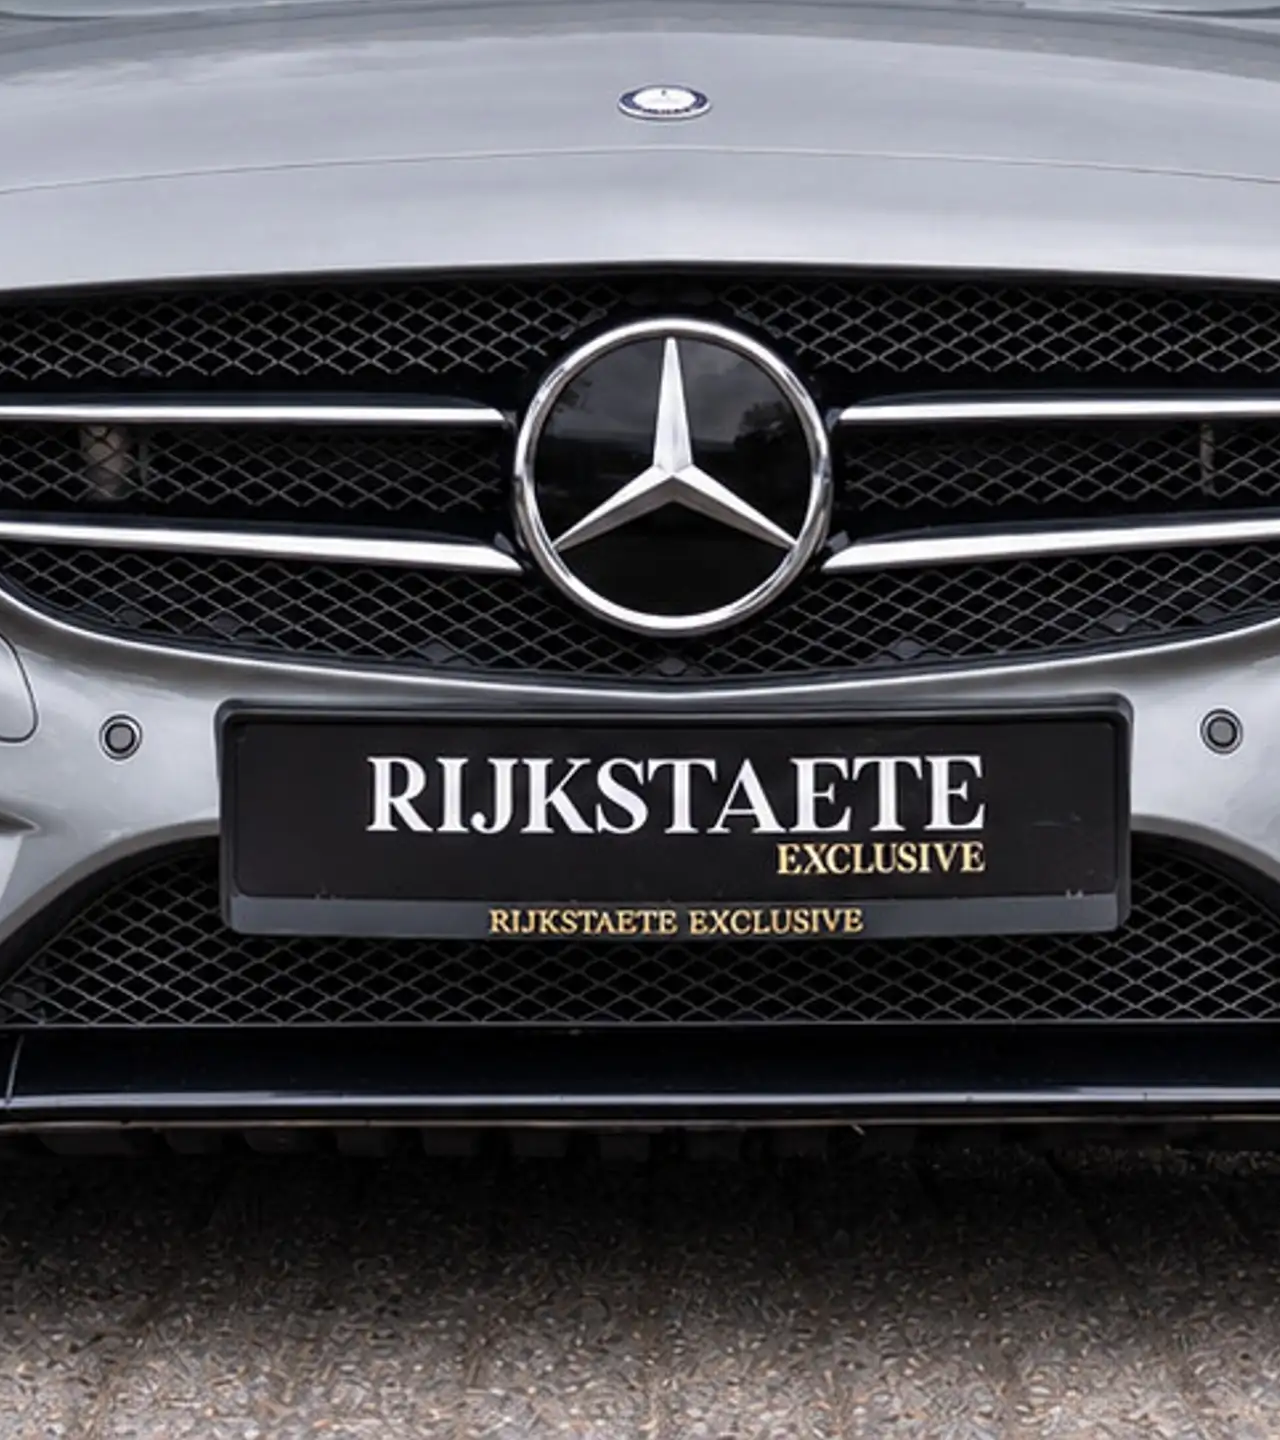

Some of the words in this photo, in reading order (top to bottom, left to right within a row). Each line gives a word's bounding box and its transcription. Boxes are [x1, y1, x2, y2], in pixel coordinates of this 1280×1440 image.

[365, 754, 986, 835] RIJKSTAETE
[776, 841, 986, 877] EXCLUSIVE
[488, 908, 678, 937] RIJKSTAETE
[688, 908, 864, 937] EXCLUSIVE
